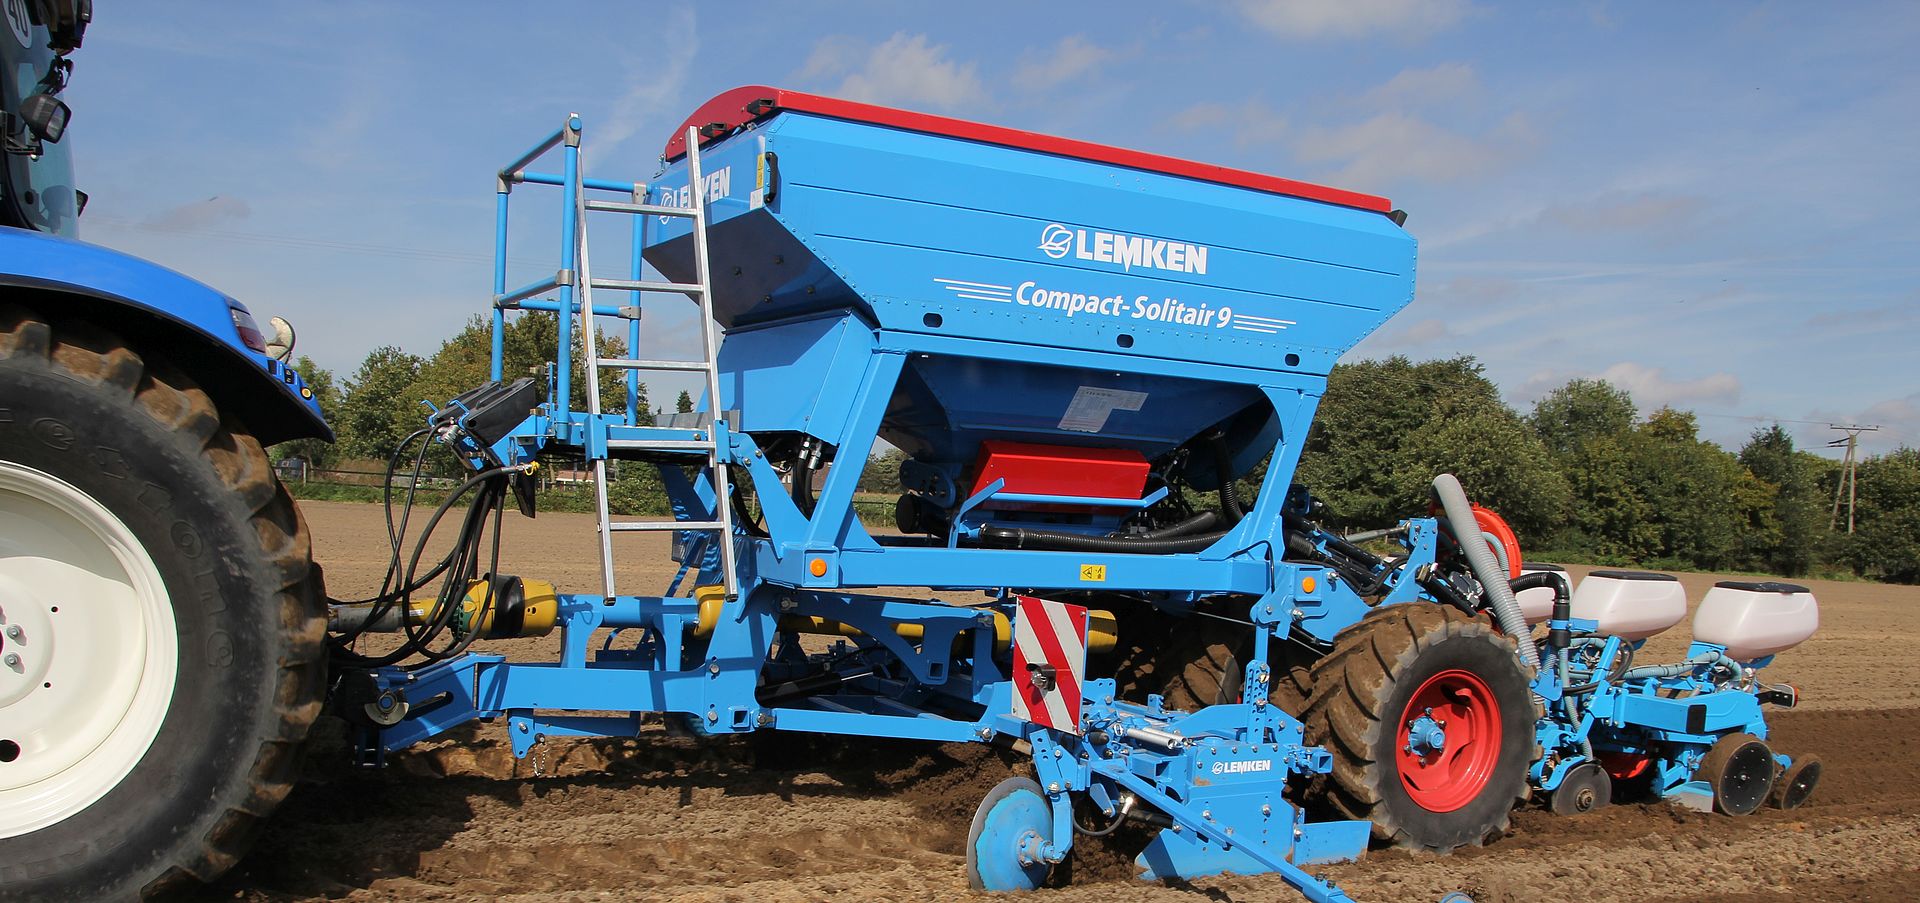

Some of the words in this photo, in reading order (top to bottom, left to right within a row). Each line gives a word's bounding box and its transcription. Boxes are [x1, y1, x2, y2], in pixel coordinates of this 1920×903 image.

[672, 166, 731, 218] LEKEN
[1076, 229, 1208, 275] LEMKEN
[1015, 281, 1215, 328] Compact-Solitair
[1216, 307, 1232, 328] 9
[1223, 760, 1271, 774] LEMKEN
